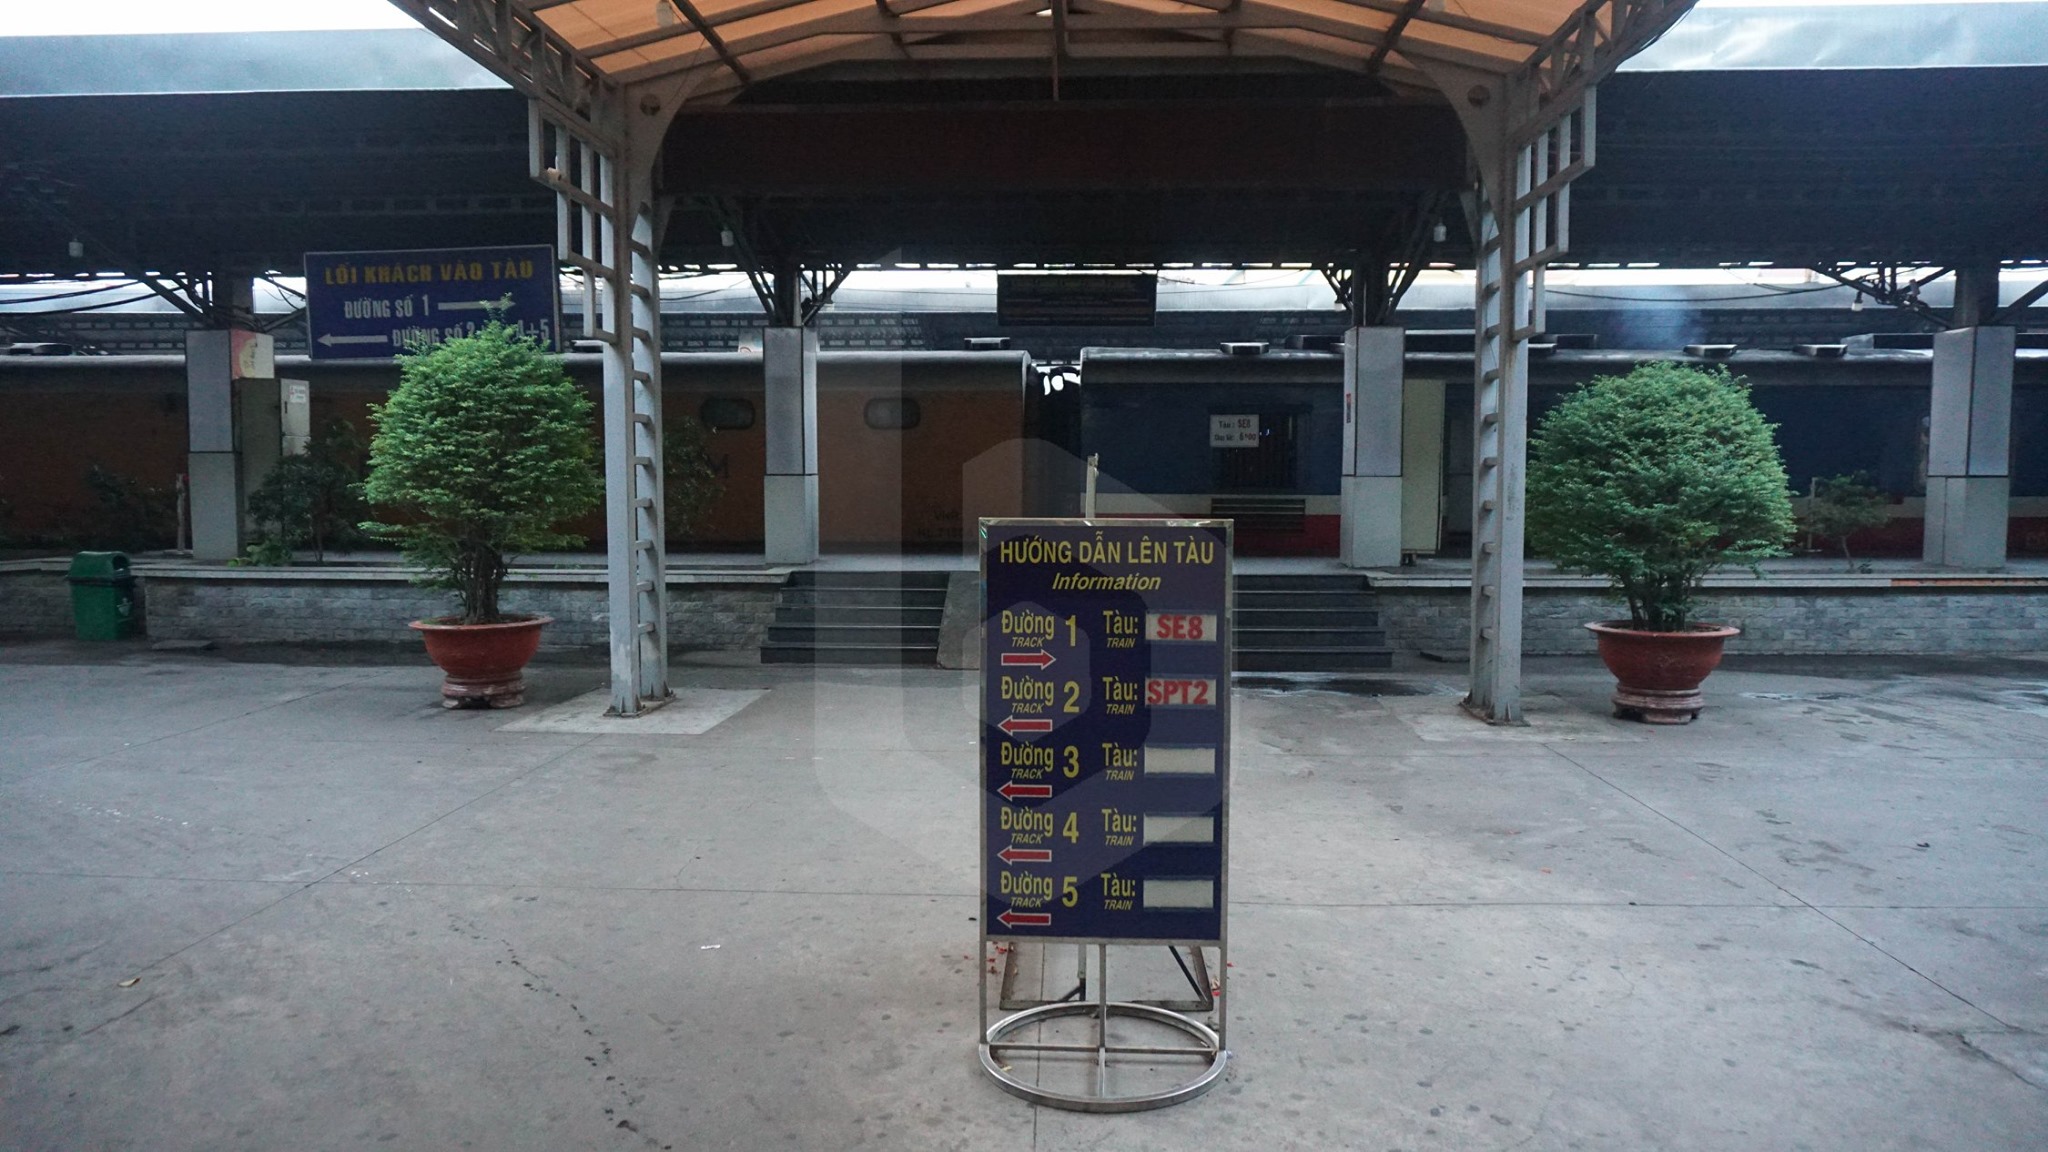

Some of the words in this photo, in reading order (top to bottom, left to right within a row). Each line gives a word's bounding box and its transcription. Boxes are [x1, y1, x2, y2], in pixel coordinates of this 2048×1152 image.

[363, 260, 432, 284] KHÁCH
[440, 259, 483, 281] VÀO
[491, 257, 534, 279] TÀU
[344, 297, 391, 319] ĐƯỜNG
[396, 293, 414, 317] SỐ
[422, 294, 430, 316] 1
[392, 325, 440, 347] ĐƯỜNG
[445, 321, 463, 340] SỐ
[1000, 535, 1072, 564] HƯỚNG
[1079, 530, 1121, 564] DẪN
[1128, 535, 1167, 564] LÊN
[1173, 535, 1214, 564] TÀU
[1052, 572, 1161, 590] Information
[1001, 609, 1055, 640] Đường
[1065, 614, 1077, 647] 1
[1103, 609, 1139, 634] Tàu:
[1157, 614, 1203, 640] SE8
[1011, 636, 1045, 647] TRACK
[1107, 637, 1136, 648] TRAIN
[1001, 675, 1054, 706] Đường
[1063, 680, 1080, 713] 2
[1102, 675, 1138, 701] Tàu:
[1146, 679, 1208, 705] SPT2
[1011, 702, 1044, 713] TRACK
[1106, 704, 1135, 715] TRAIN
[1001, 741, 1054, 772] Đường
[1063, 745, 1079, 778] 3
[1102, 742, 1137, 767] Tàu:
[1011, 768, 1043, 780] TRACK
[1105, 770, 1135, 781] TRAIN
[1000, 806, 1053, 837] Đường
[1062, 812, 1079, 844] 4
[1101, 807, 1137, 832] Tàu:
[1010, 833, 1043, 844] TRACK
[1105, 836, 1134, 846] TRAIN
[1000, 870, 1053, 901] Đường
[1062, 875, 1078, 908] 5
[1100, 872, 1136, 897] Tàu:
[1010, 897, 1043, 908] TRACK
[1104, 899, 1133, 911] TRAIN
